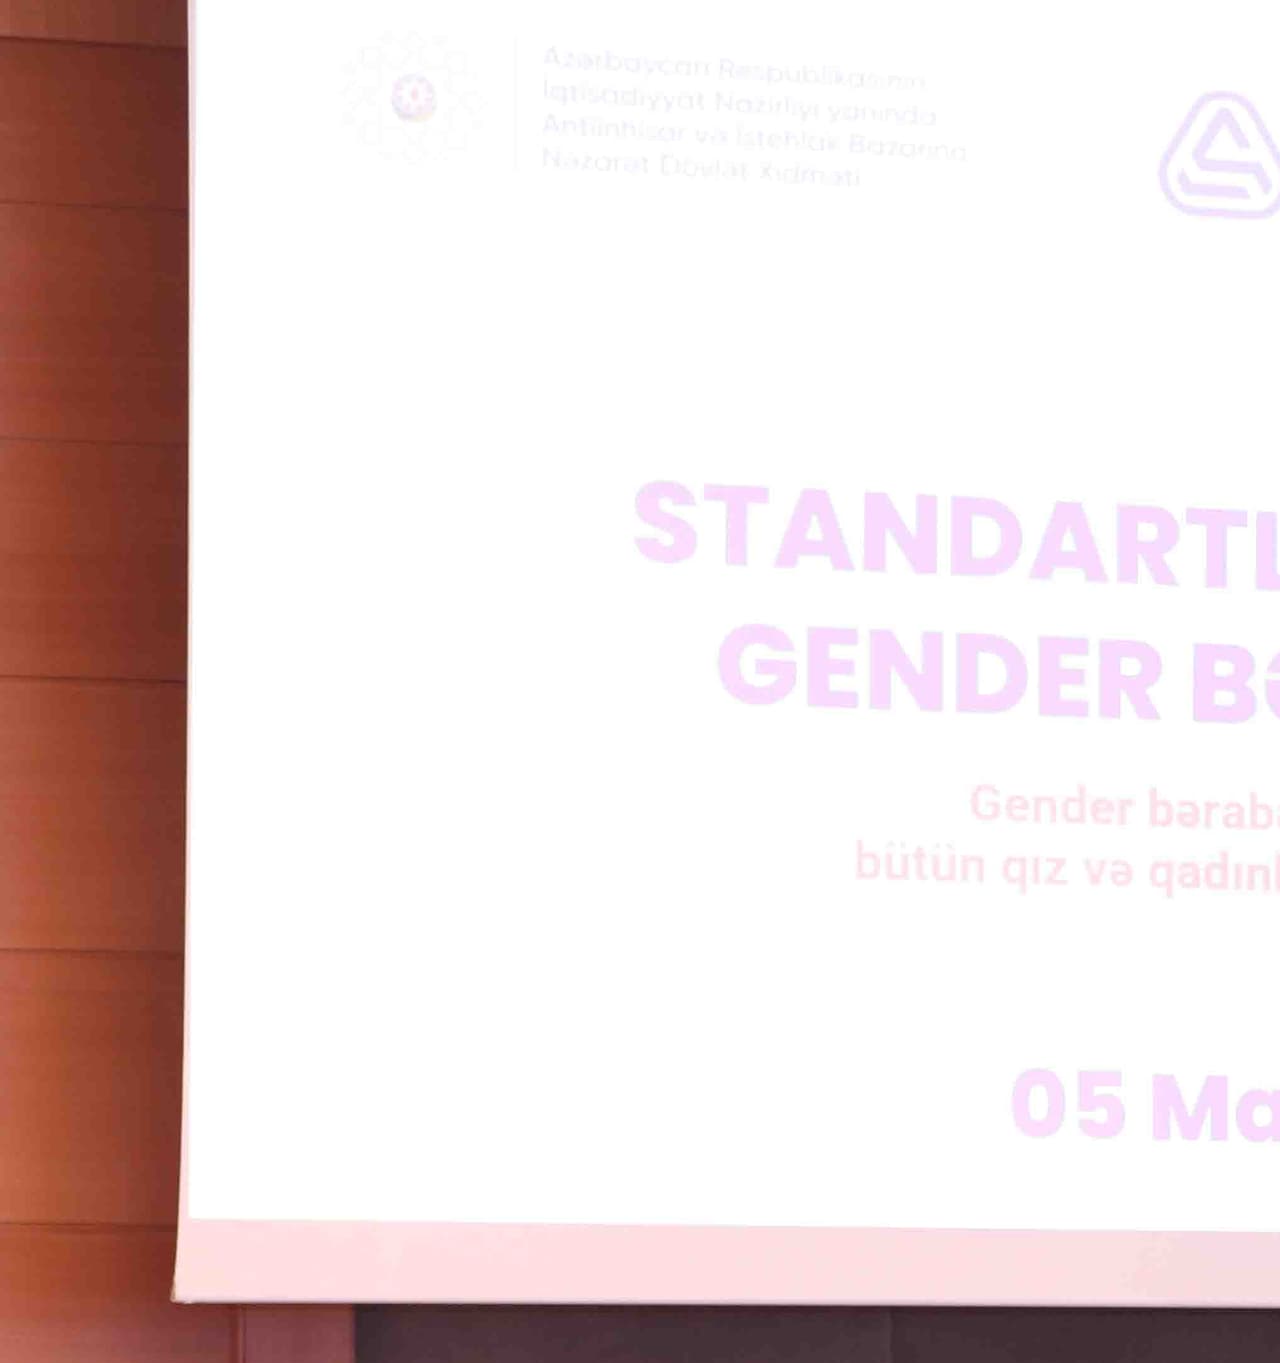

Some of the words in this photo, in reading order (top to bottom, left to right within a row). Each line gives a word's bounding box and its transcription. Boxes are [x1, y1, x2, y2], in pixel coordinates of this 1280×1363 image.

[717, 622, 1163, 722] GENDER
[970, 783, 1135, 828] Gender
[854, 839, 985, 883] bütün
[1002, 855, 1068, 896] qız
[1085, 859, 1134, 890] və
[1011, 1068, 1127, 1139] 05
